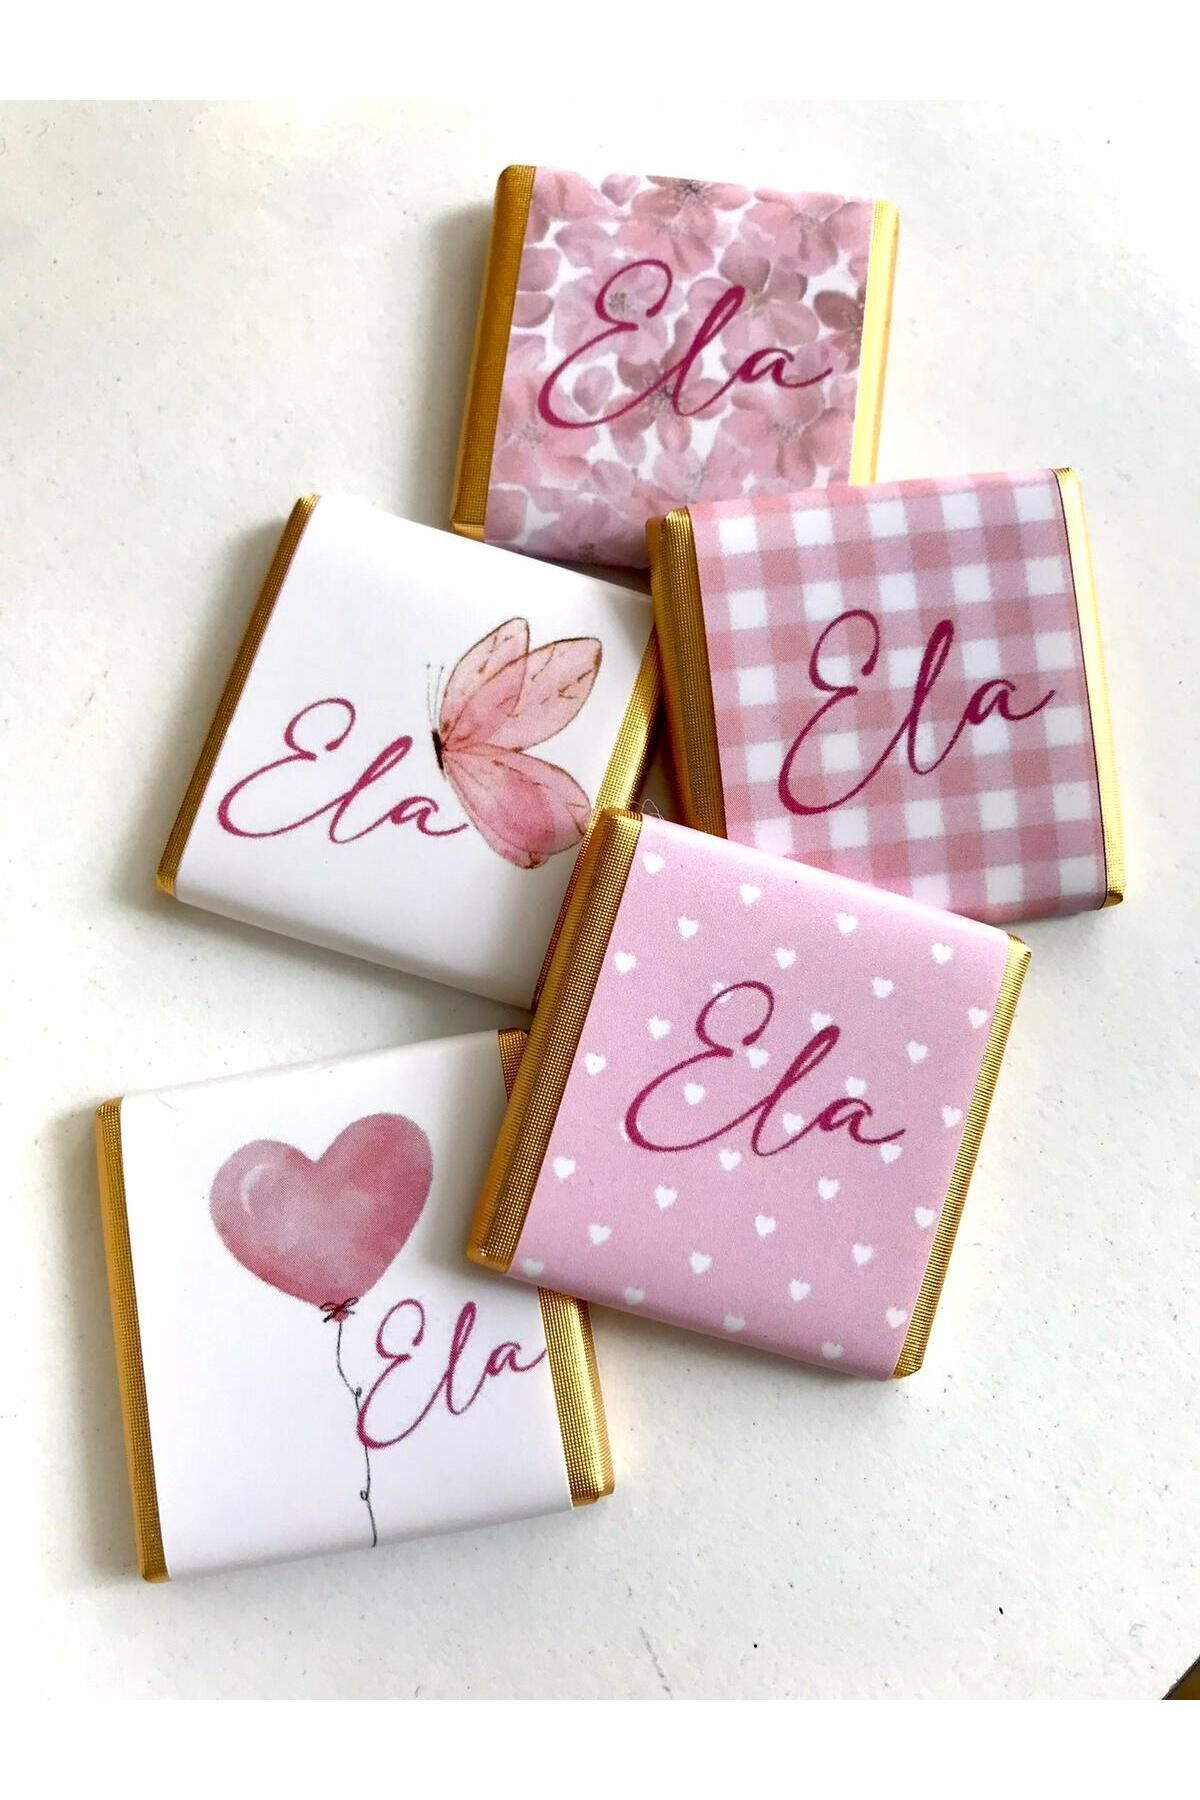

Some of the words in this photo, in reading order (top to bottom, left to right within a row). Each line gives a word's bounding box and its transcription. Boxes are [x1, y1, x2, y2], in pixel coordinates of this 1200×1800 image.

[537, 258, 834, 431] Ela
[217, 697, 471, 844] Ela
[777, 609, 1056, 816] Ela
[624, 980, 907, 1158] Ela
[357, 1299, 547, 1449] Ela
